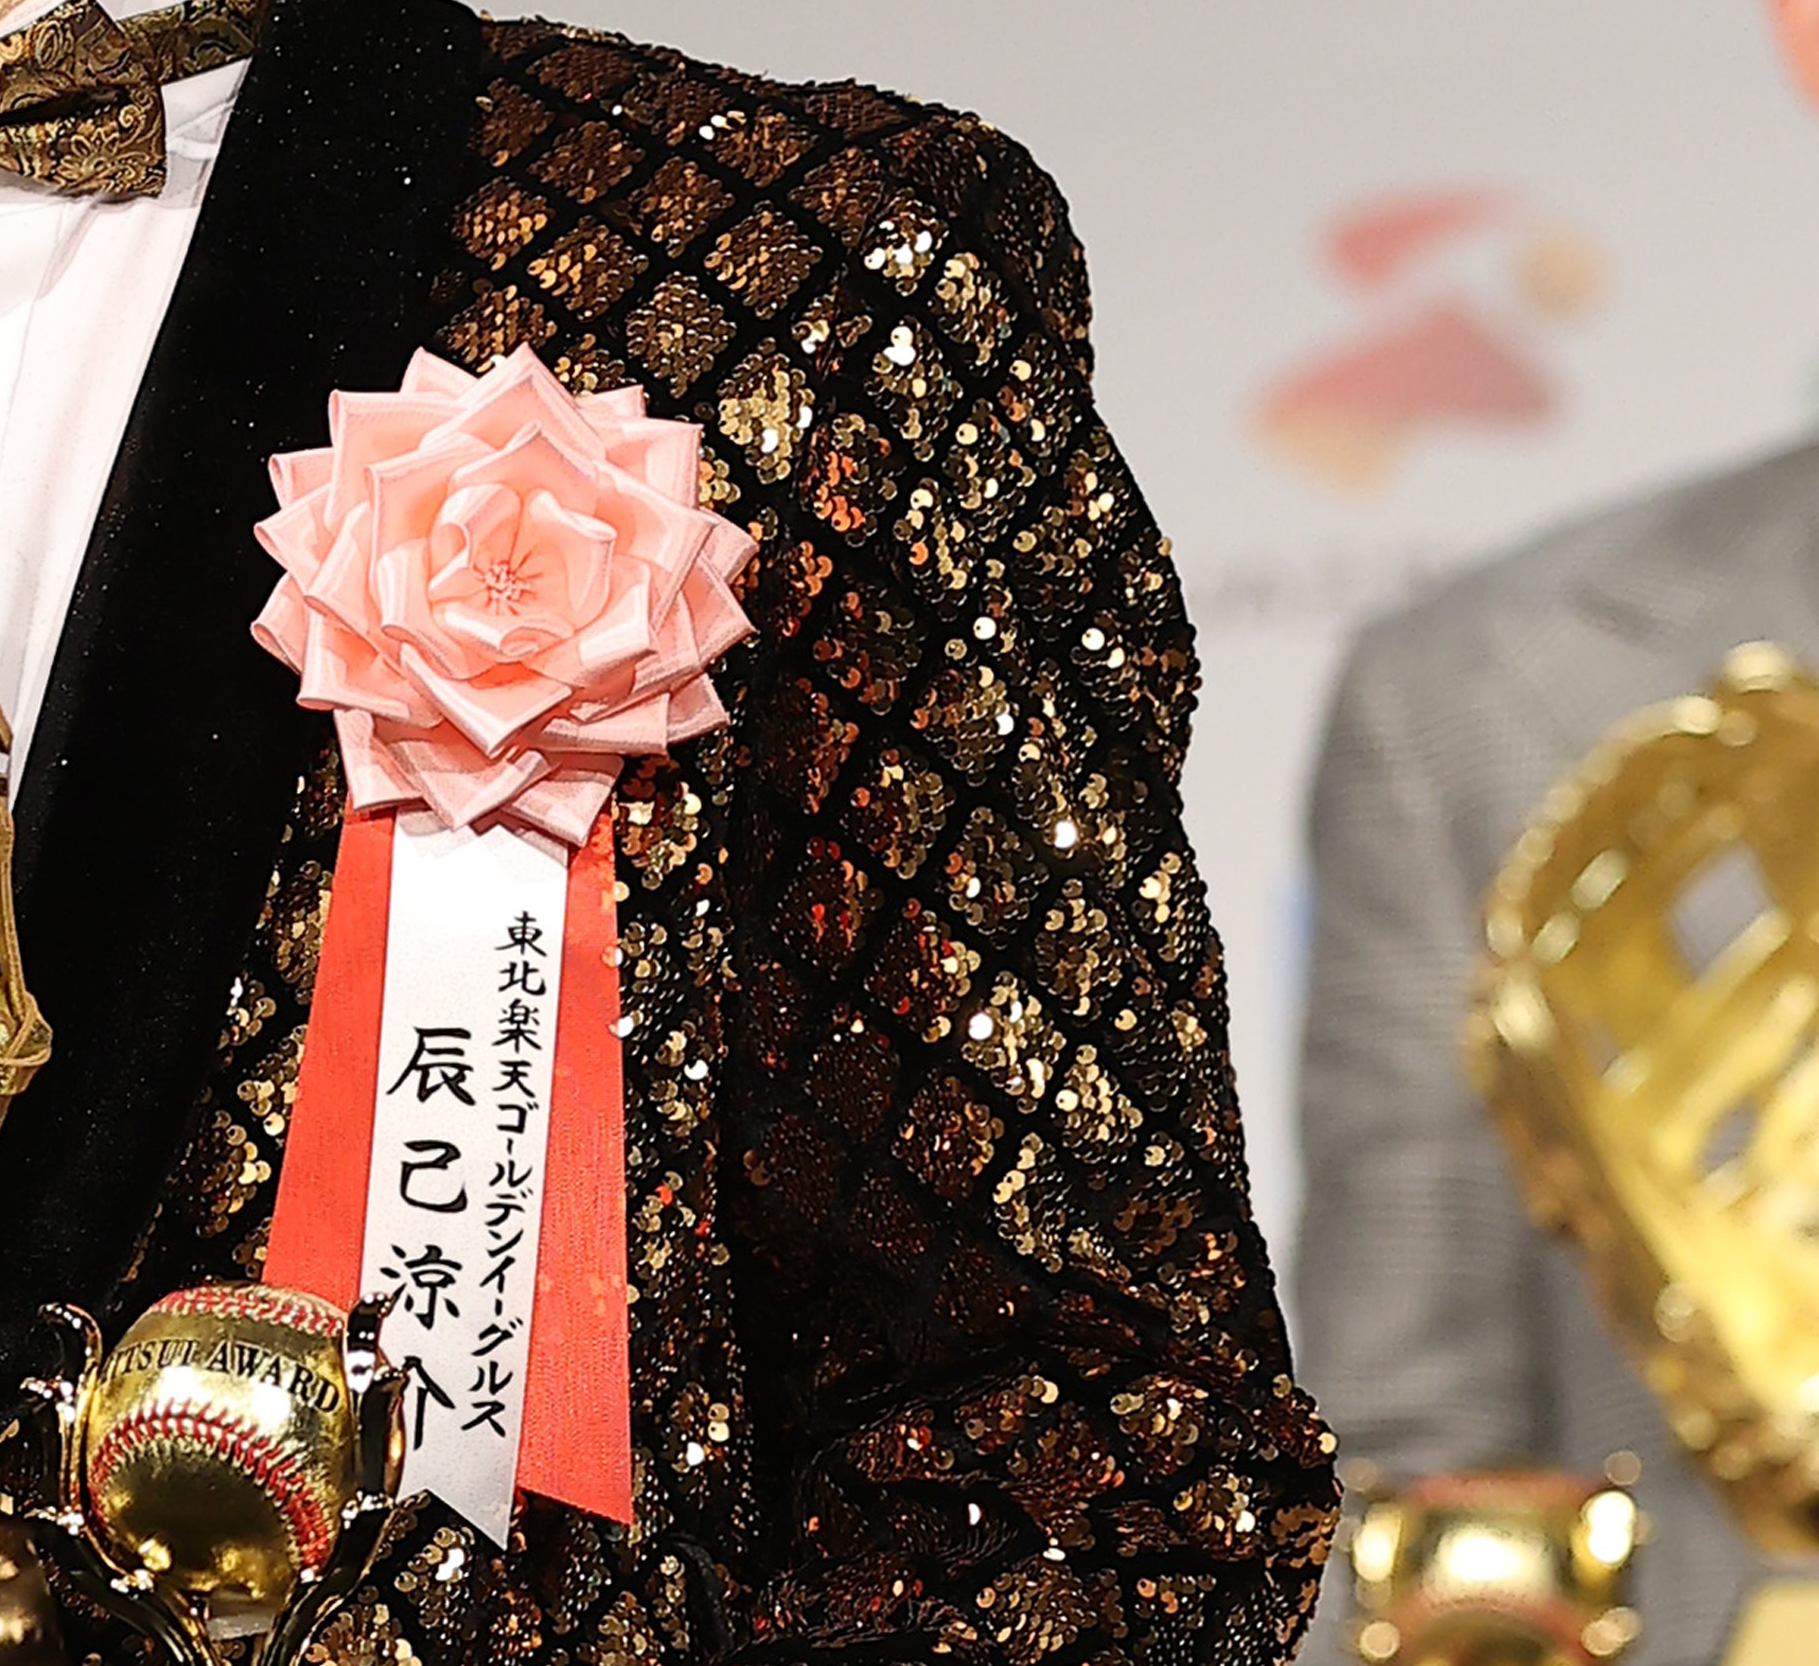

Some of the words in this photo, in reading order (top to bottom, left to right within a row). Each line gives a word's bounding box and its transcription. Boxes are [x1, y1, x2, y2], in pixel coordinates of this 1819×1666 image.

[460, 910, 547, 1438] 東北楽天ゴールデンイーグルス
[98, 1336, 199, 1386] ITSUI
[207, 1339, 341, 1414] AWARD
